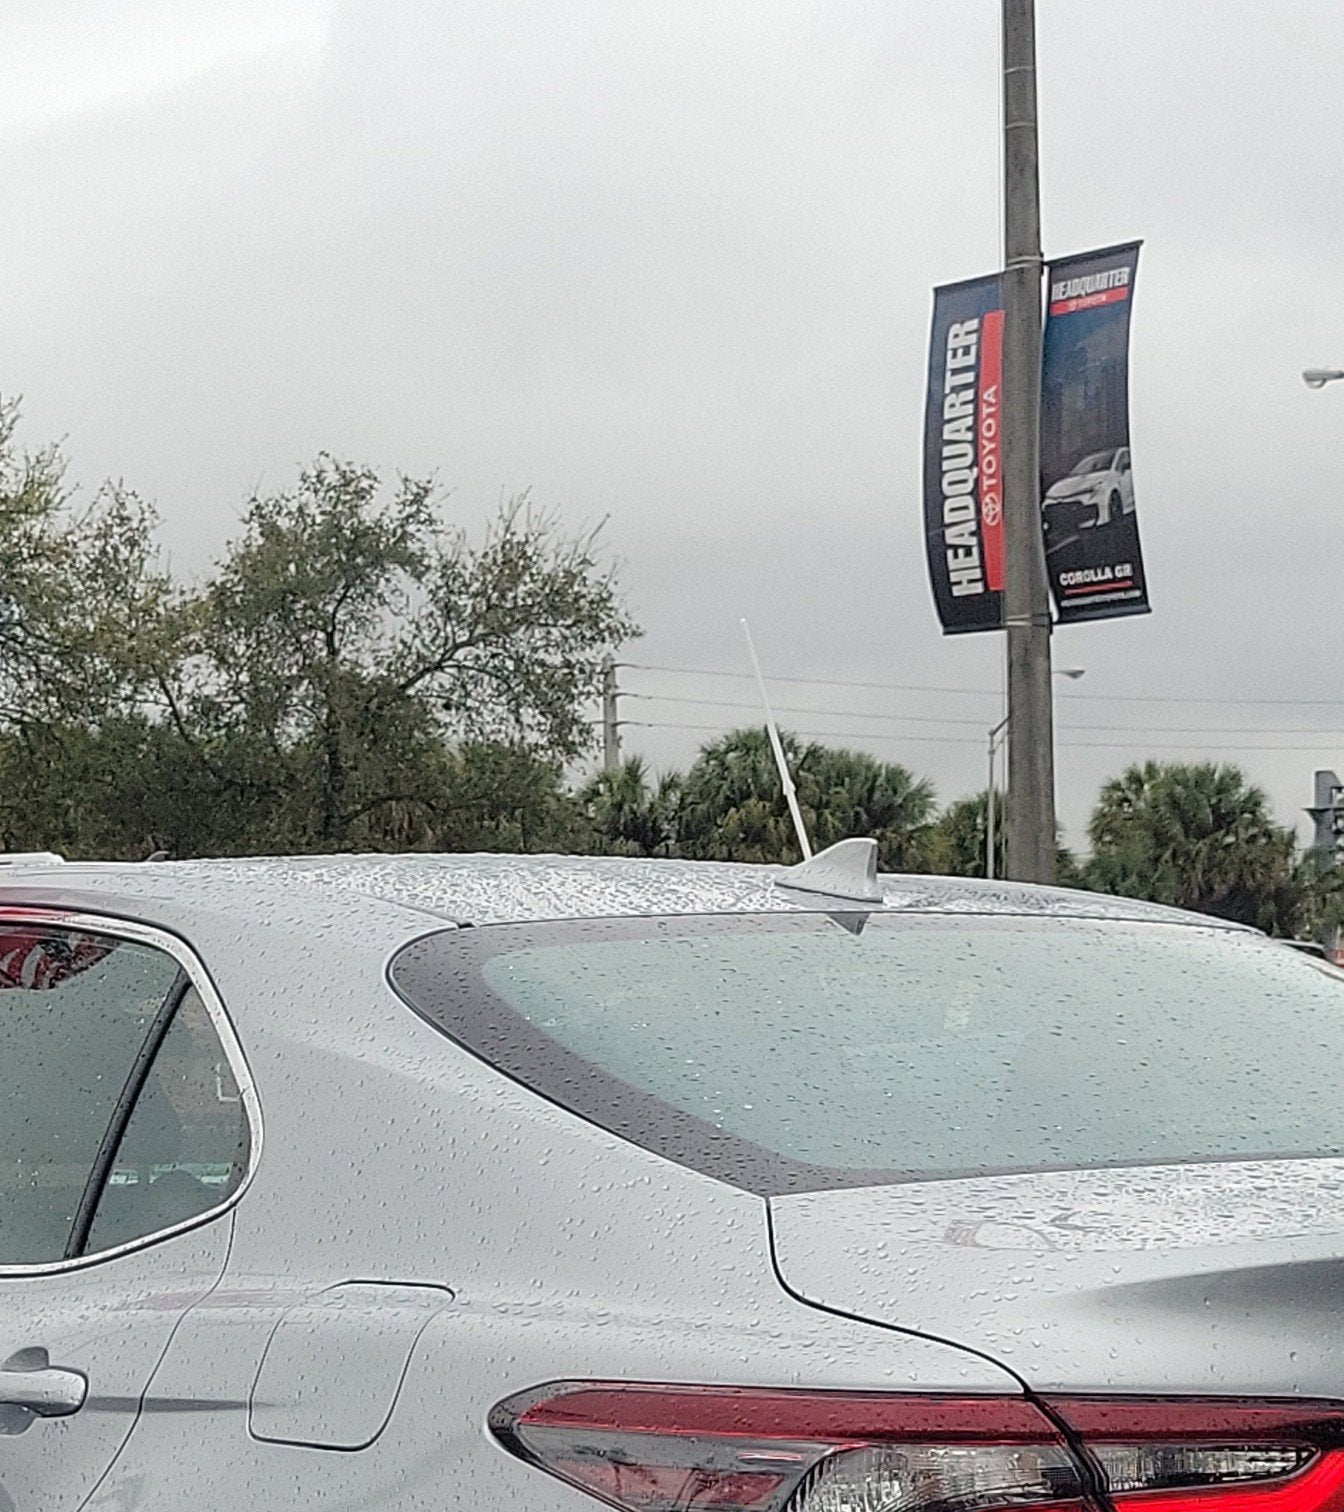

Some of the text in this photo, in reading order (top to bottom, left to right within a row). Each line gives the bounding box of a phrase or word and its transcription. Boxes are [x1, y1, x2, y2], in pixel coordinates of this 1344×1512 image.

[941, 317, 984, 598] HEADQUARTER
[982, 384, 999, 492] TOYOTA
[1059, 563, 1134, 587] COROLLA GR
